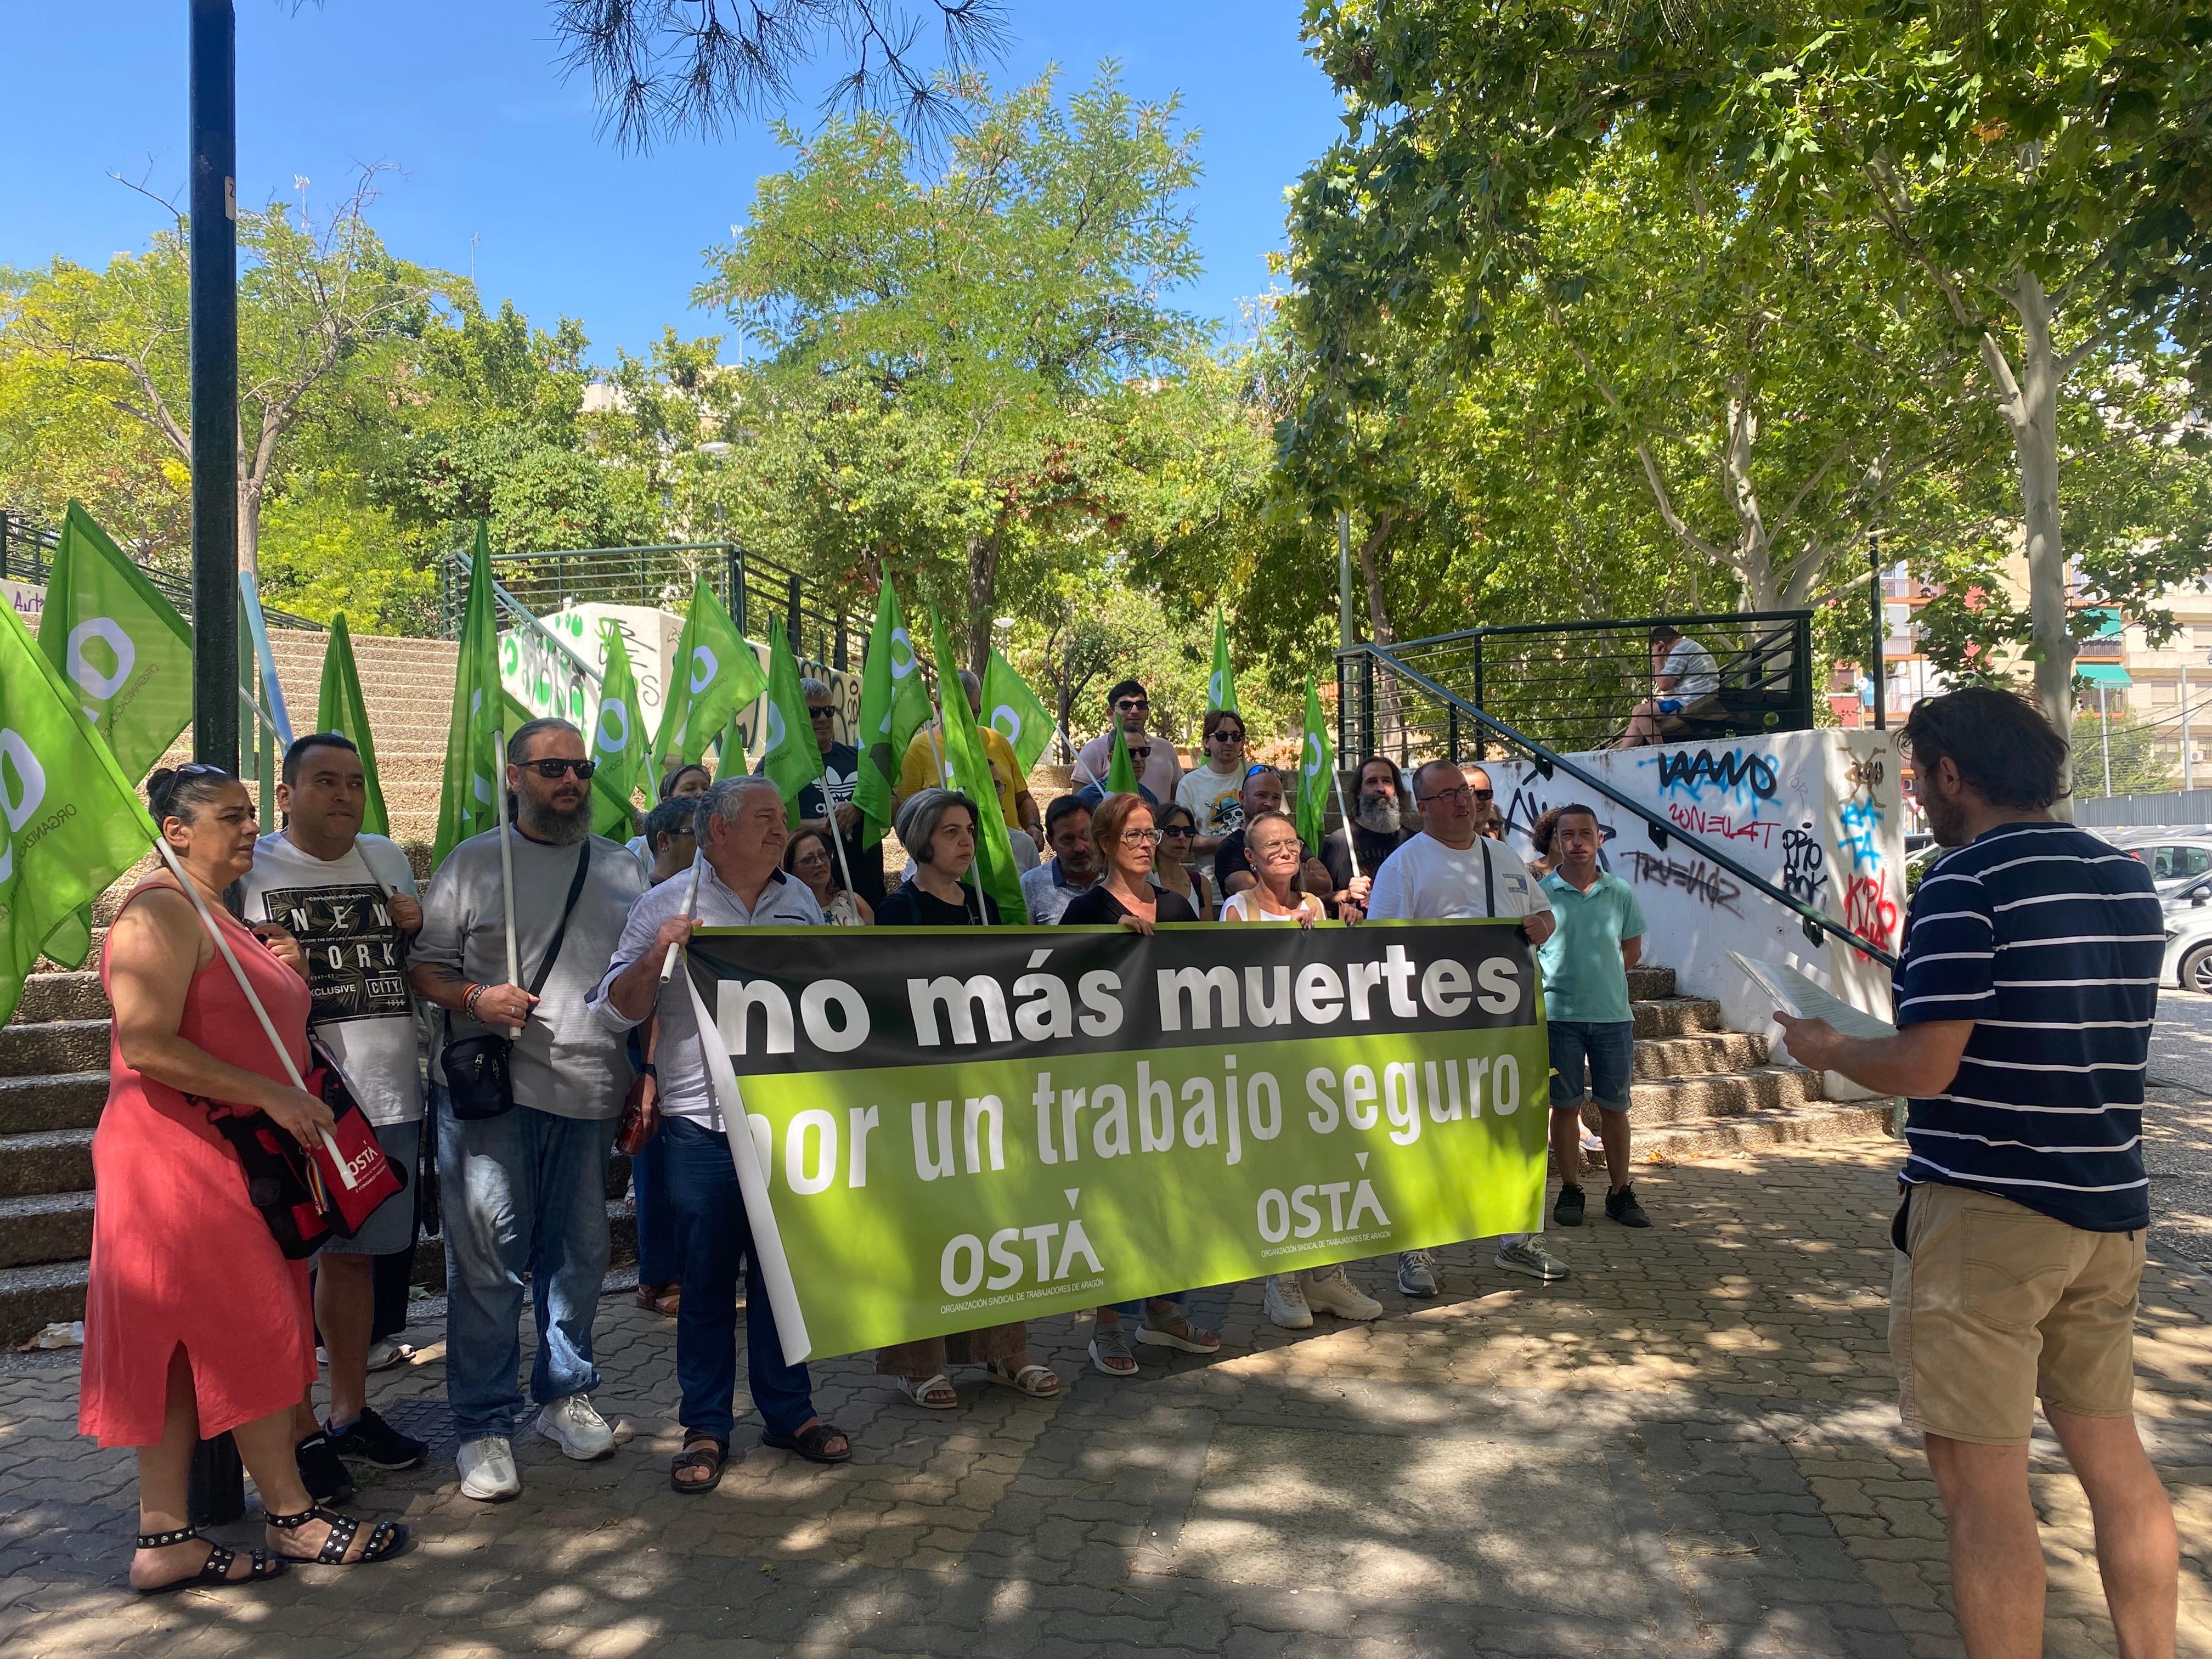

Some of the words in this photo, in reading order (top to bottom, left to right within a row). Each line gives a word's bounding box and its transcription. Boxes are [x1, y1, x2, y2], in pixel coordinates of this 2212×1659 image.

[310, 984, 357, 997] XCLUSIVE
[371, 980, 399, 994] CITY
[716, 979, 870, 1055] no
[907, 949, 1123, 1046] más
[1156, 945, 1521, 1031] muertes
[911, 1094, 1005, 1181] un
[1032, 1054, 1282, 1165] trabajo
[1305, 1054, 1521, 1146] seguro
[1261, 1245, 1297, 1257] ORGANIZACIÓN
[1297, 1242, 1318, 1251] SINDICAL
[1326, 1235, 1362, 1246] TRABAJADORES
[1370, 1231, 1391, 1240] ARAGÓN
[940, 1298, 988, 1314] ORGANIZACIÓN
[988, 1294, 1015, 1305] SINDICAL
[1017, 1292, 1025, 1301] DE
[1026, 1284, 1071, 1299] TRABAJADORES
[1071, 1283, 1080, 1291] DE
[1080, 1277, 1104, 1289] ARAGÓN
